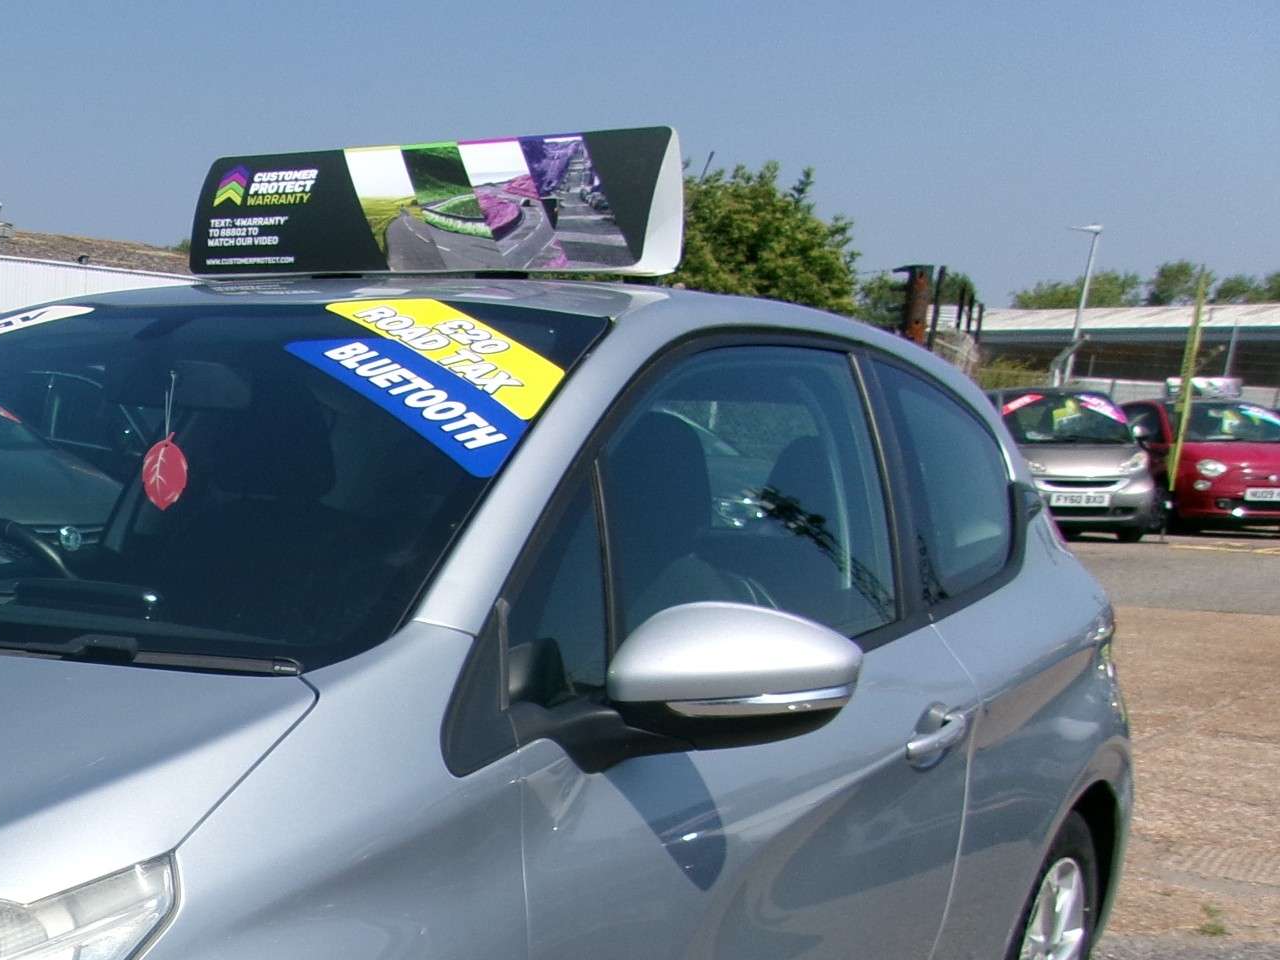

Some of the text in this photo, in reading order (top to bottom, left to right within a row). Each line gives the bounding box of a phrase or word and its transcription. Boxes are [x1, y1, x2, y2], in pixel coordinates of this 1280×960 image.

[253, 169, 318, 182] CUSTOMER
[249, 180, 315, 195] PROTECT
[246, 193, 311, 206] WARRANTY
[208, 229, 219, 237] TO
[248, 227, 259, 236] TO
[207, 236, 279, 247] WATCH OUR VIDEO
[433, 319, 510, 354] £20
[353, 305, 524, 396] ROAD TAX
[322, 340, 509, 451] BLUETOOTH
